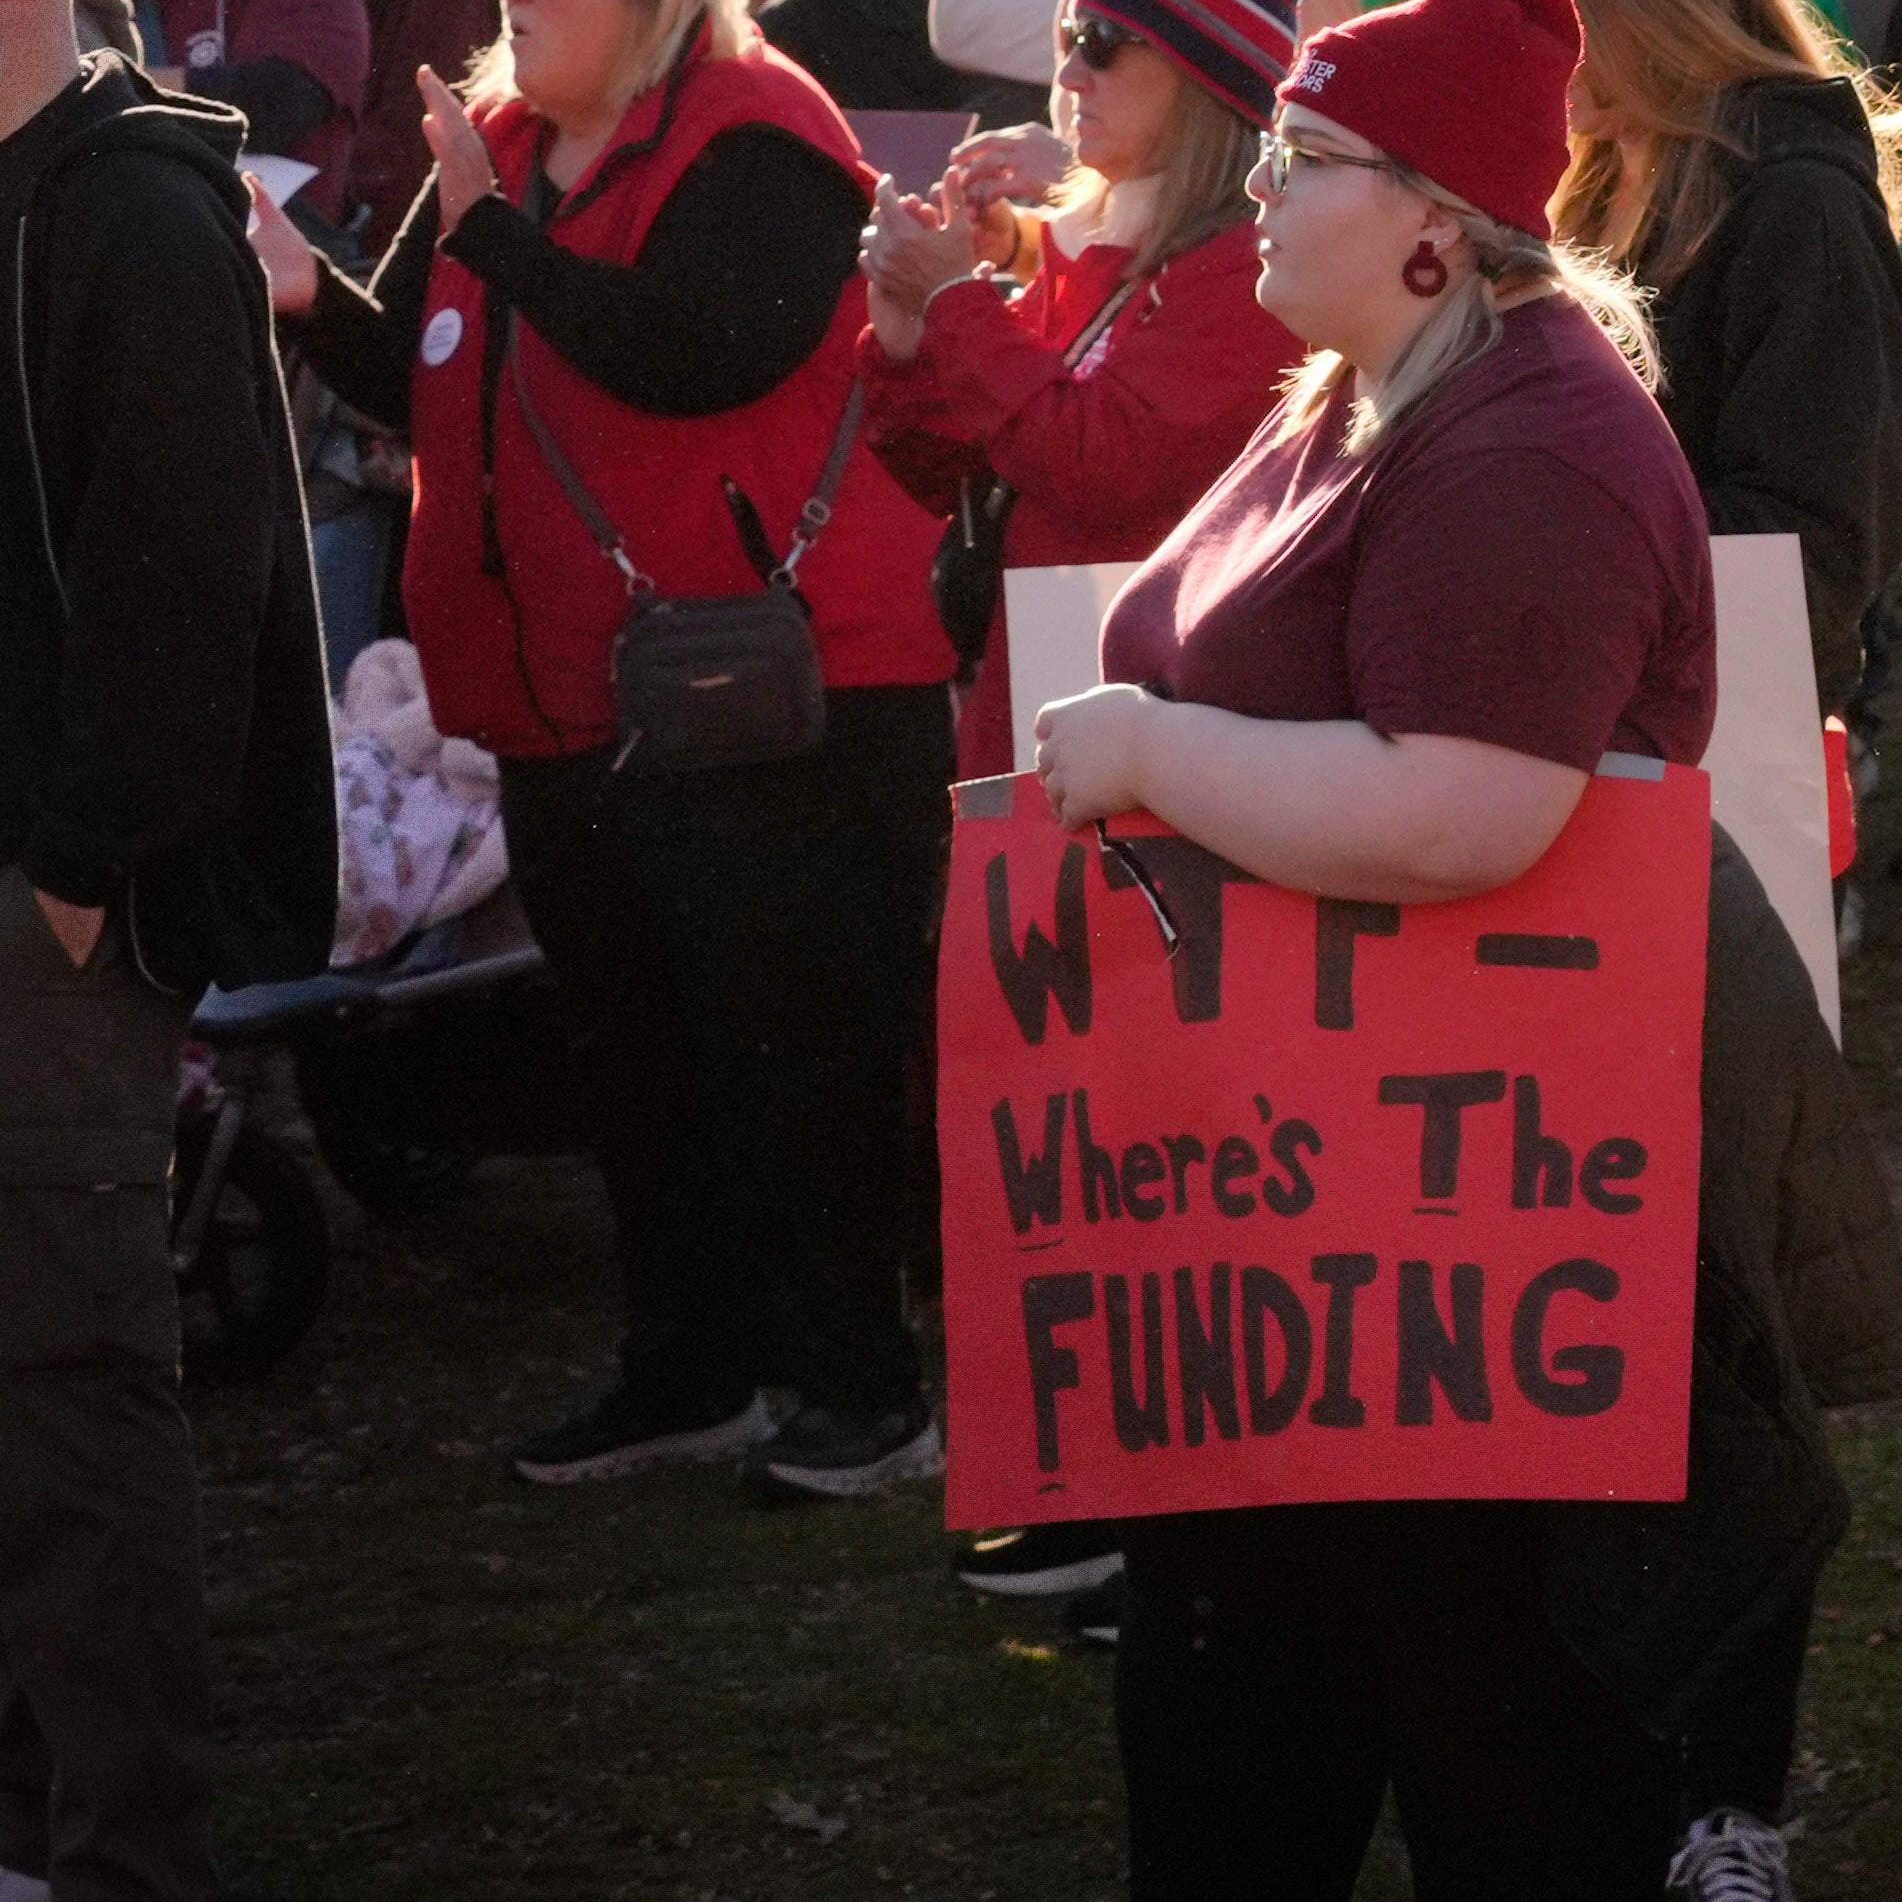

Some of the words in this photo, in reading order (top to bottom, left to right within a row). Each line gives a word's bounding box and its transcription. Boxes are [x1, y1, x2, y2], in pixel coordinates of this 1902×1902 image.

[991, 1088, 1323, 1238] Where's
[1378, 1070, 1648, 1216] The
[1022, 1252, 1626, 1472] FUNDING
